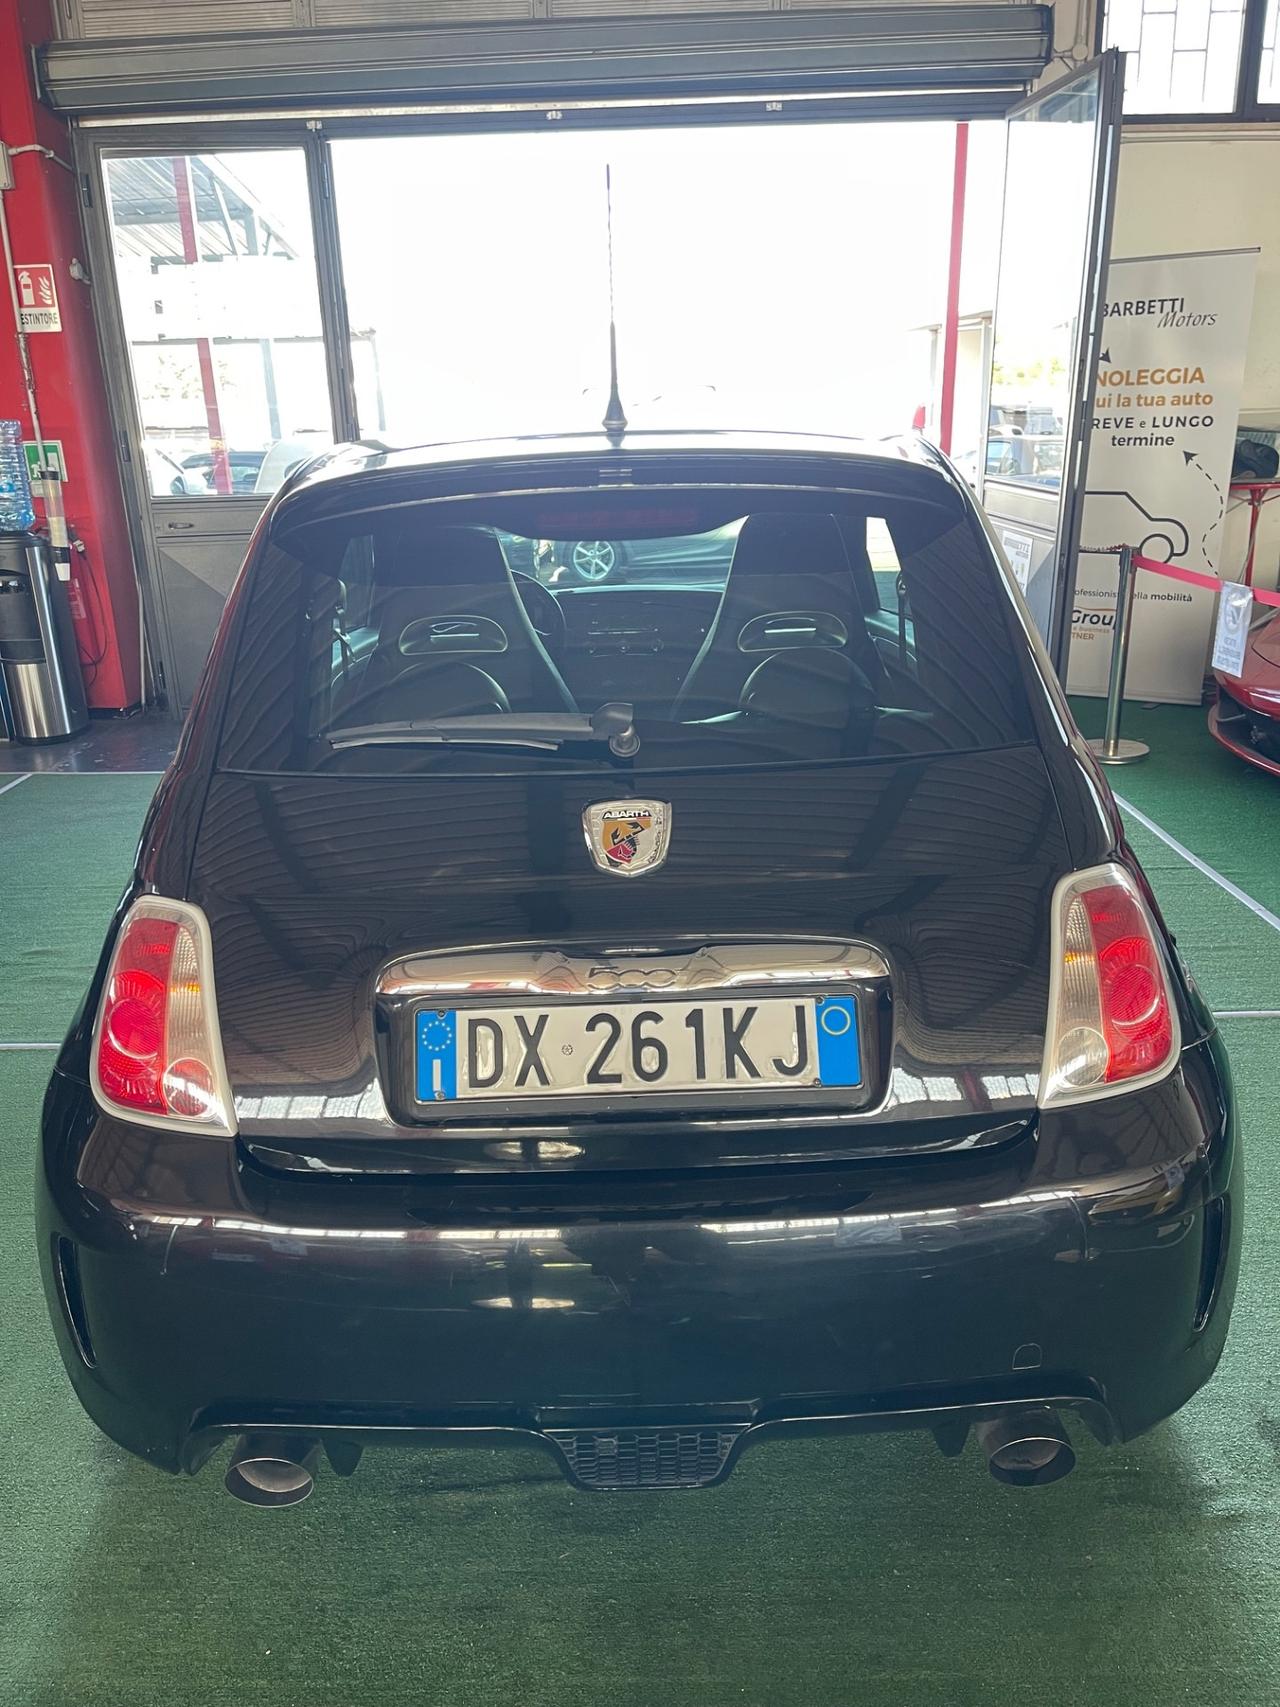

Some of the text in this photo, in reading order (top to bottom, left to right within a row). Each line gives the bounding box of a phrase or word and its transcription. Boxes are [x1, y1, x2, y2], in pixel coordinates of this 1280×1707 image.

[20, 312, 58, 325] ESTINTORE
[1157, 311, 1218, 328] Motors
[1097, 366, 1205, 387] NOLEGGIA
[1095, 391, 1214, 408] ui la tua auto
[1092, 415, 1214, 430] REVE e LUNGO
[1111, 432, 1175, 447] termine
[1151, 592, 1193, 602] mobilità
[1071, 632, 1095, 641] TNER
[603, 810, 649, 819] ABARTH
[588, 965, 677, 990] 500
[468, 1014, 550, 1088] DX
[585, 1005, 808, 1084] 261KJ
